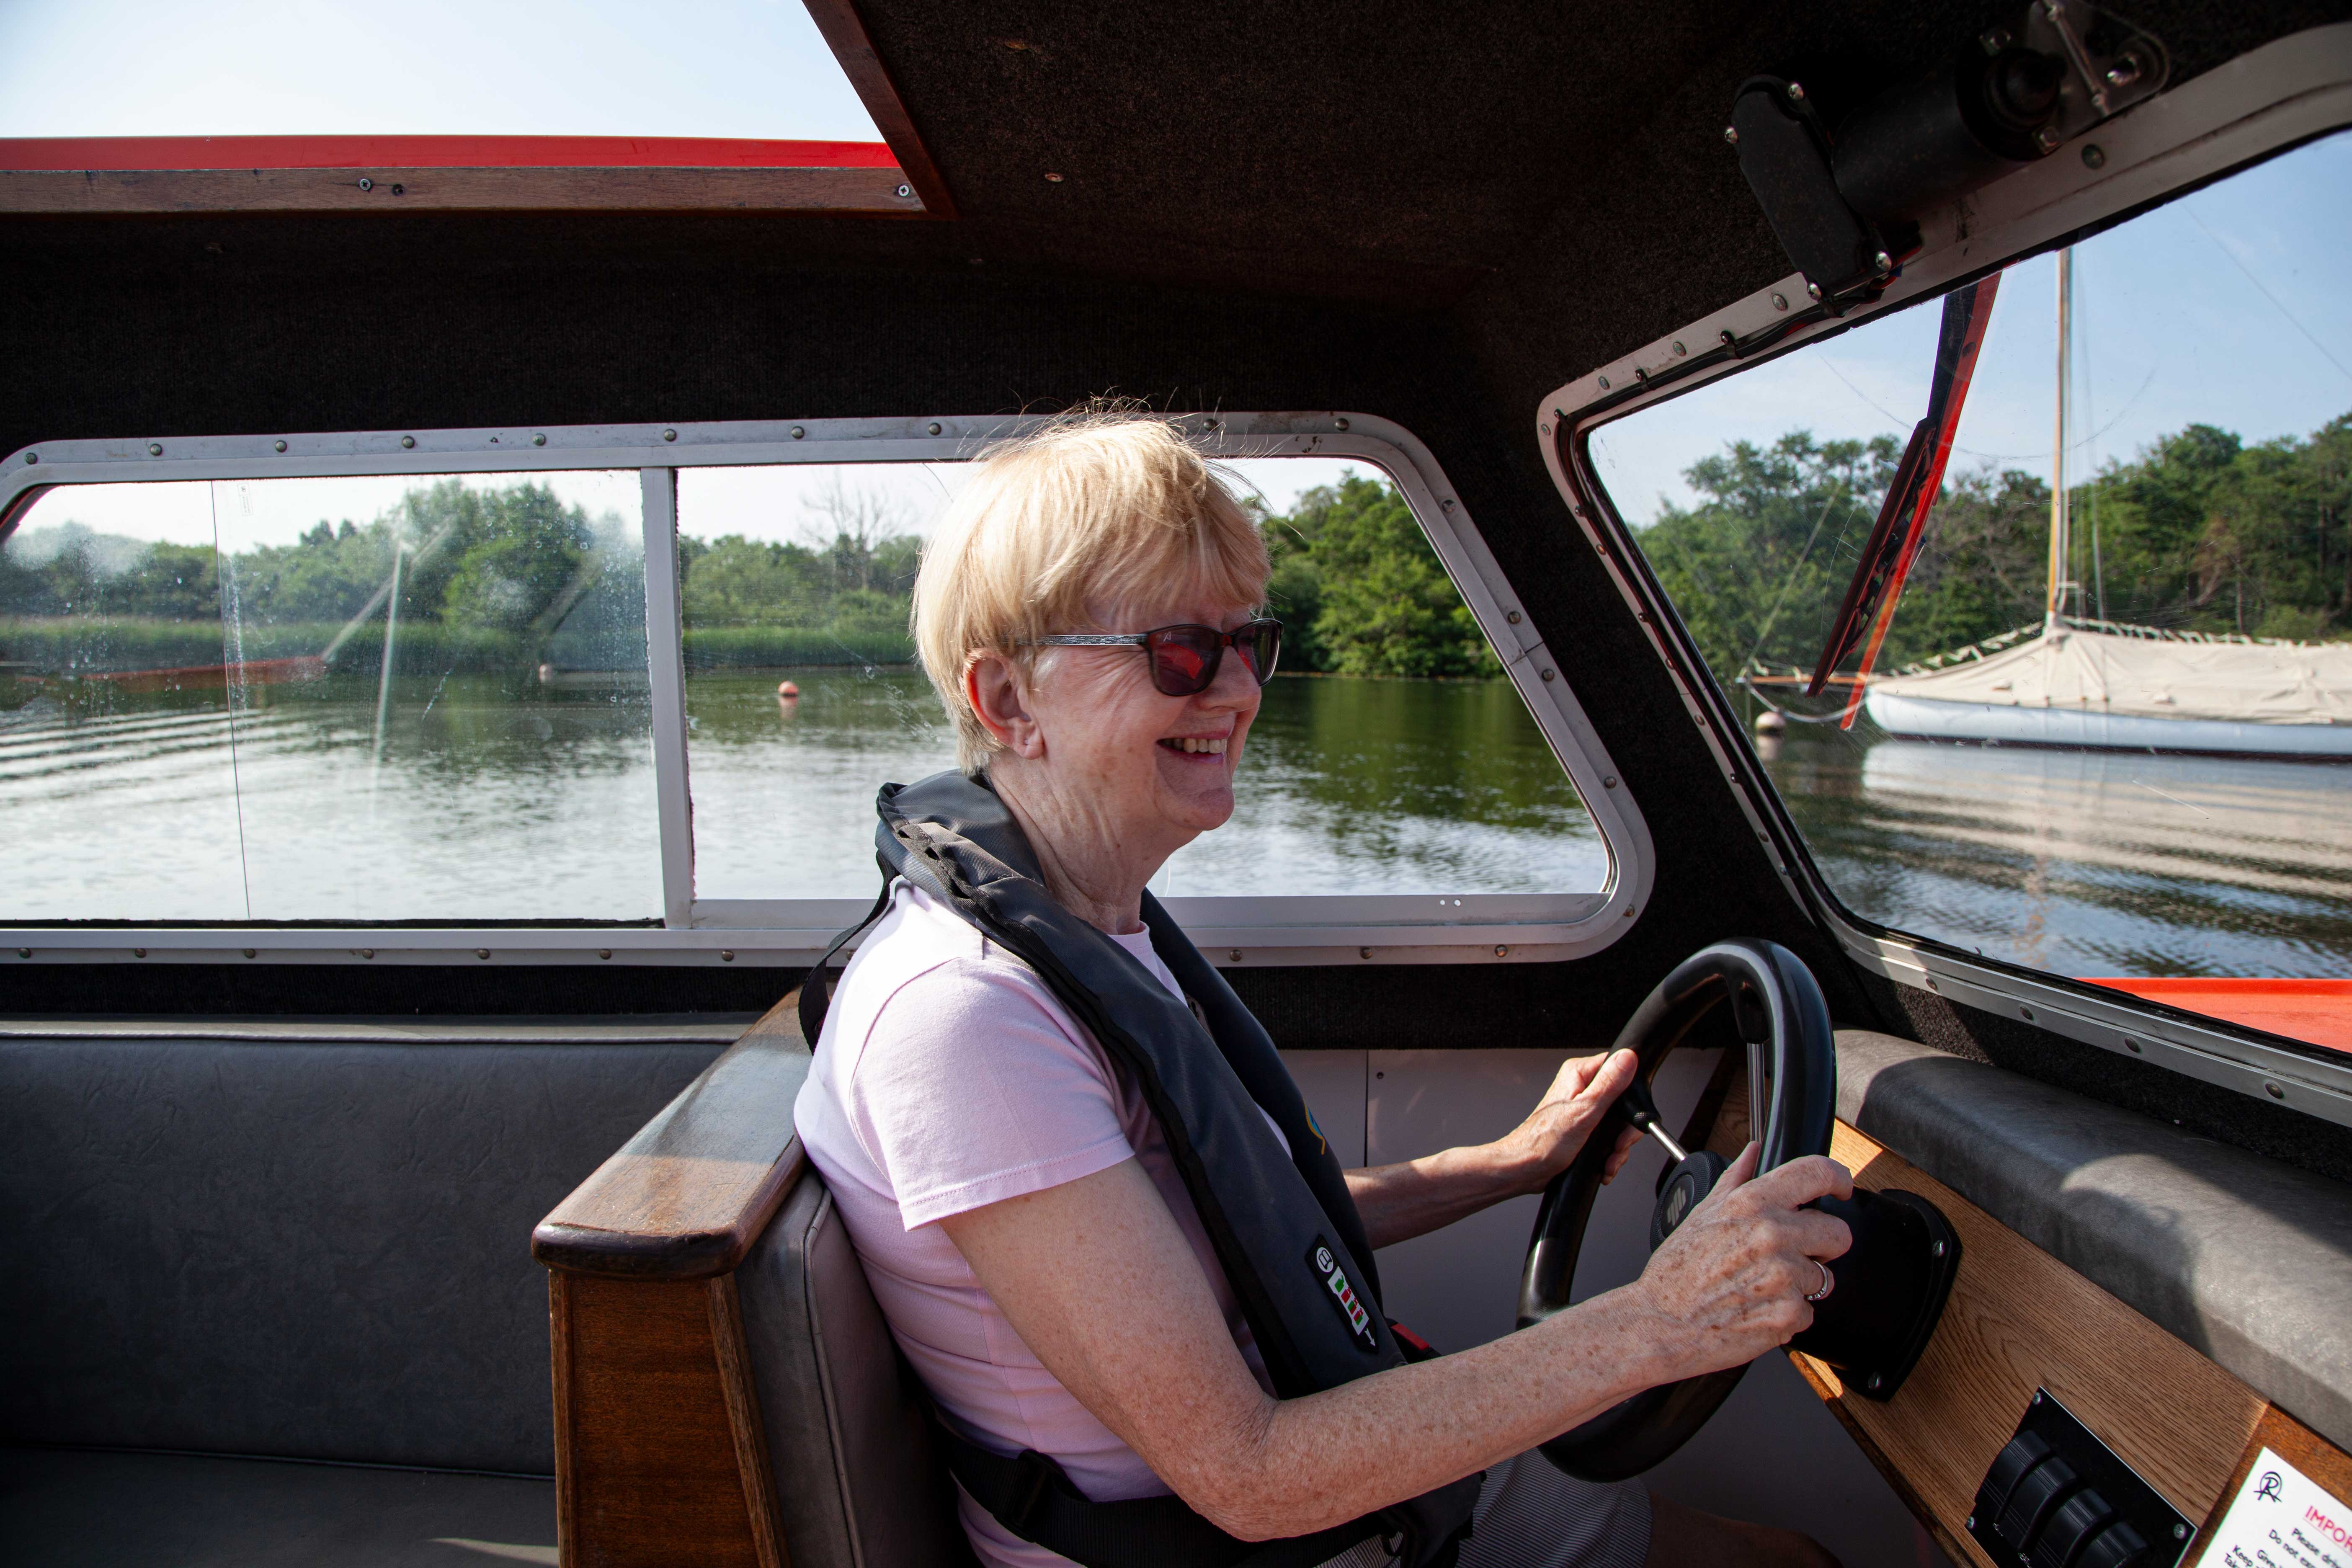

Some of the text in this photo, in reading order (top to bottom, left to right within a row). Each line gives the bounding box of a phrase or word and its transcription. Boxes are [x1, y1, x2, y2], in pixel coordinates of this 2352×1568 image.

[2269, 1529, 2282, 1544] Do
[2283, 1543, 2299, 1558] not
[2292, 1528, 2319, 1556] Please
[2224, 1552, 2241, 1568] Tak
[2232, 1544, 2253, 1568] Keep
